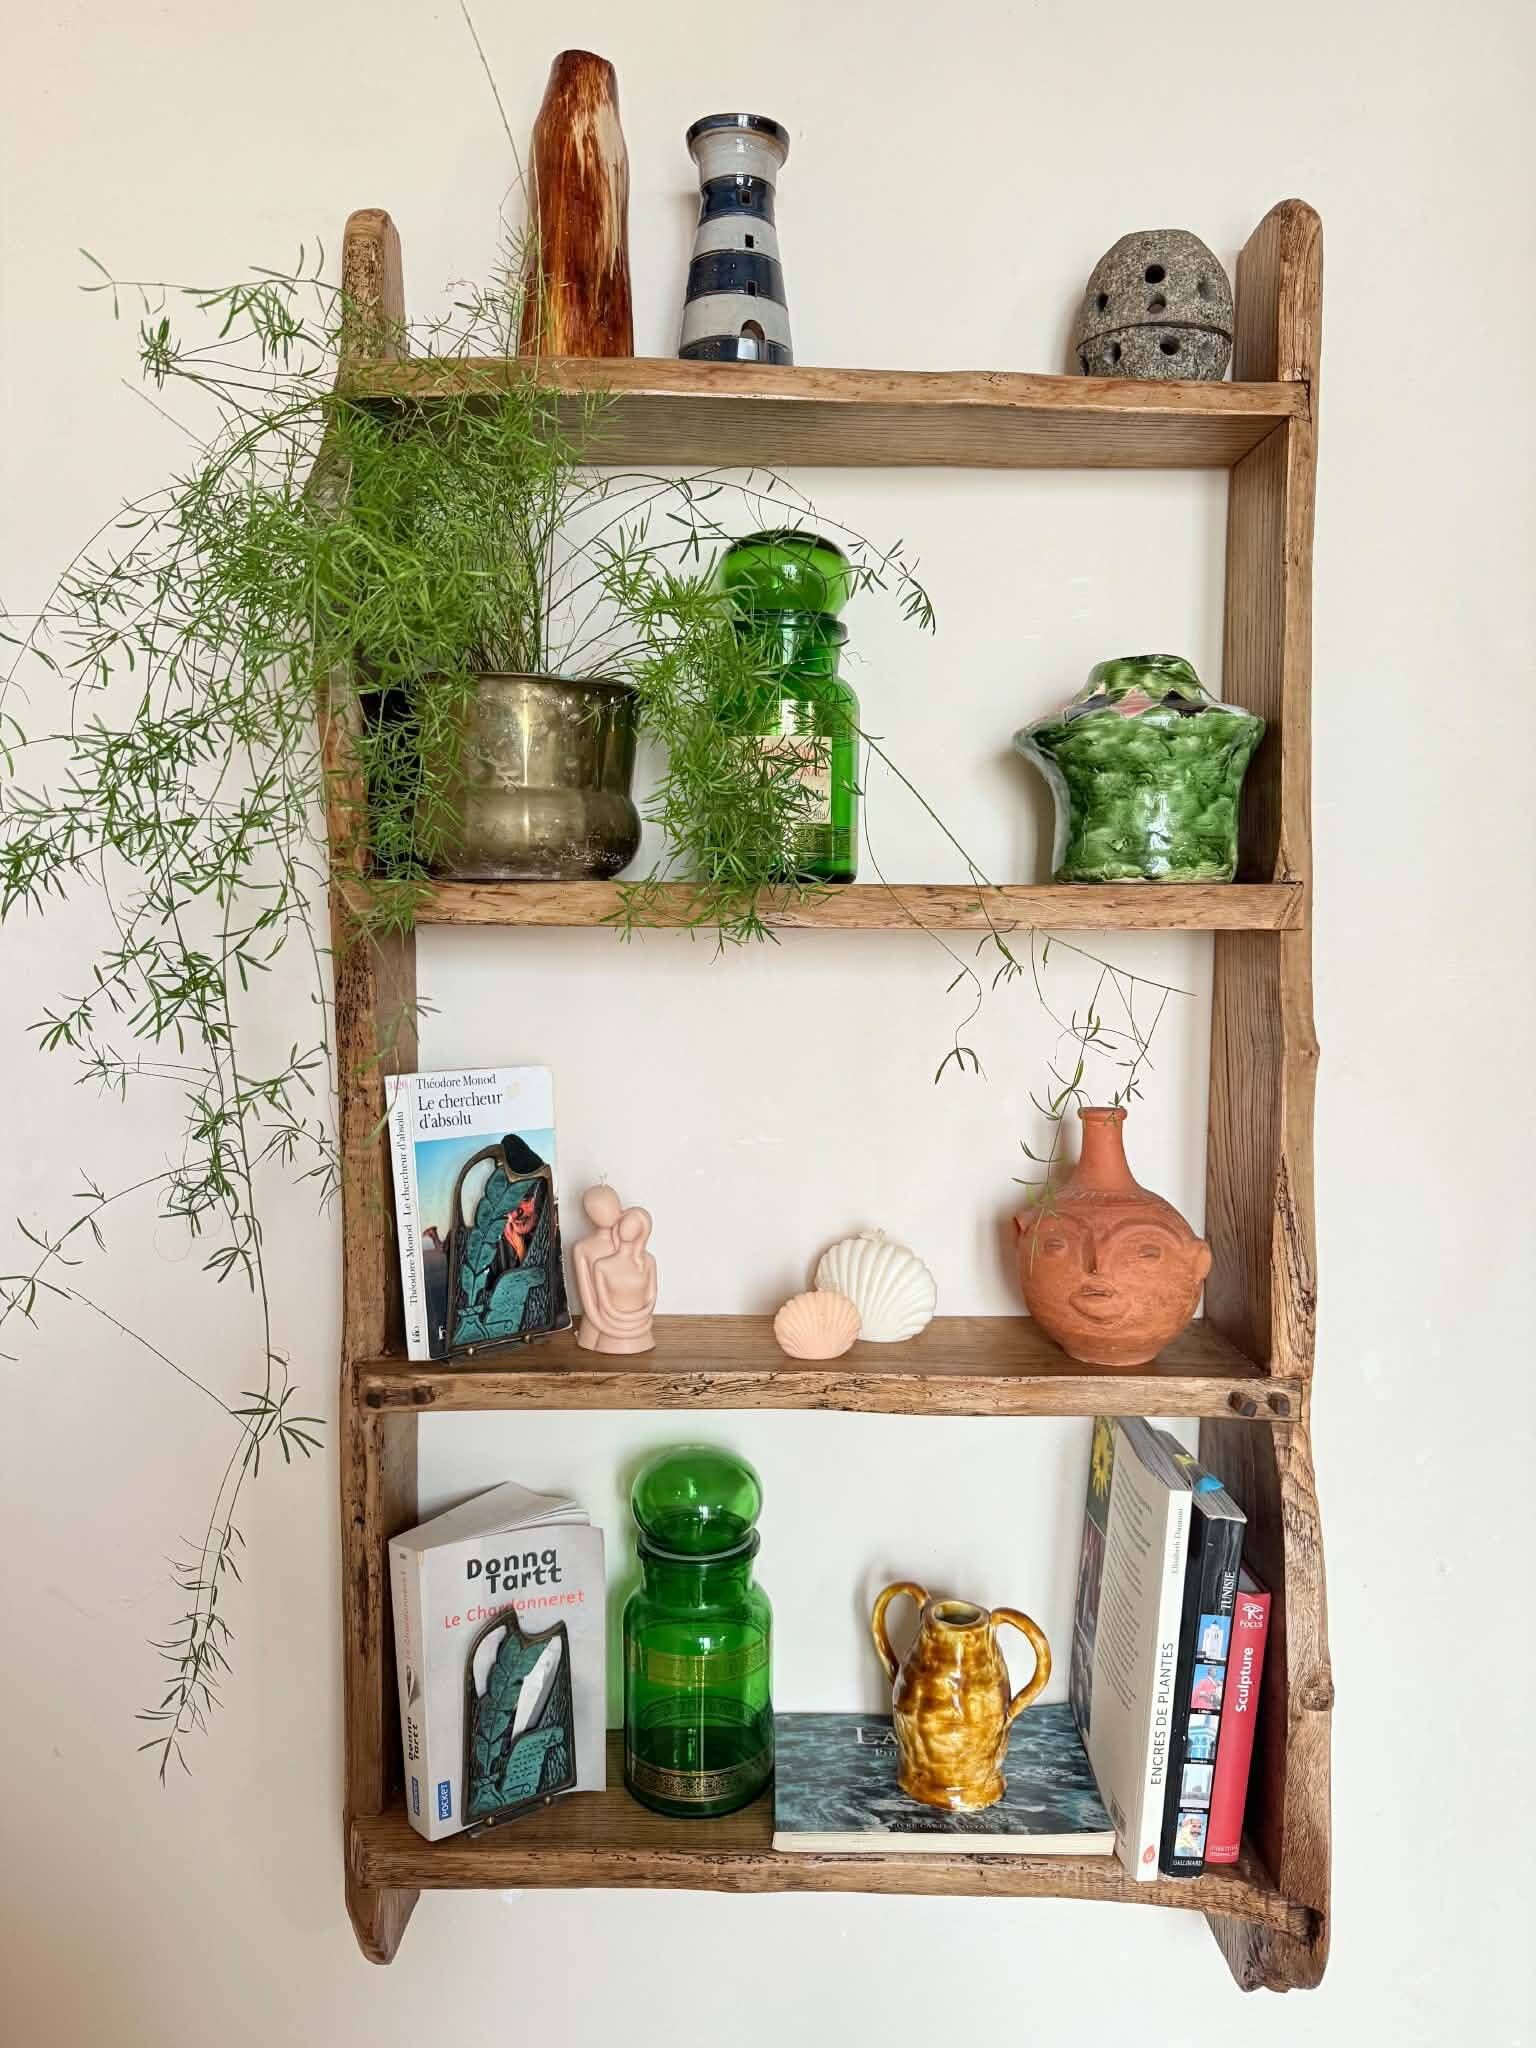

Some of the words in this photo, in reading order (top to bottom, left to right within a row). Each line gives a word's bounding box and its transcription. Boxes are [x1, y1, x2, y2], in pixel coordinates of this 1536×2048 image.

[416, 1077, 461, 1089] Théodore
[463, 1074, 496, 1086] Monod
[418, 1096, 435, 1111] Le
[438, 1091, 502, 1109] chercheur
[419, 1110, 472, 1129] d'absolu
[400, 1152, 410, 1200] chercheur
[403, 1203, 411, 1215] Le
[404, 1224, 415, 1259] Monod
[407, 1259, 418, 1304] Théodore
[466, 1549, 557, 1580] Donna
[485, 1565, 562, 1594] Tartt
[1220, 1571, 1235, 1609] TUNISIE
[444, 1615, 461, 1629] Le
[1240, 1620, 1263, 1628] FOCUS
[1158, 1642, 1174, 1703] PLANTES
[1235, 1647, 1254, 1712] Sculpture
[1156, 1705, 1168, 1726] DE
[1151, 1731, 1166, 1785] ENCRES
[440, 1783, 448, 1817] POCKET
